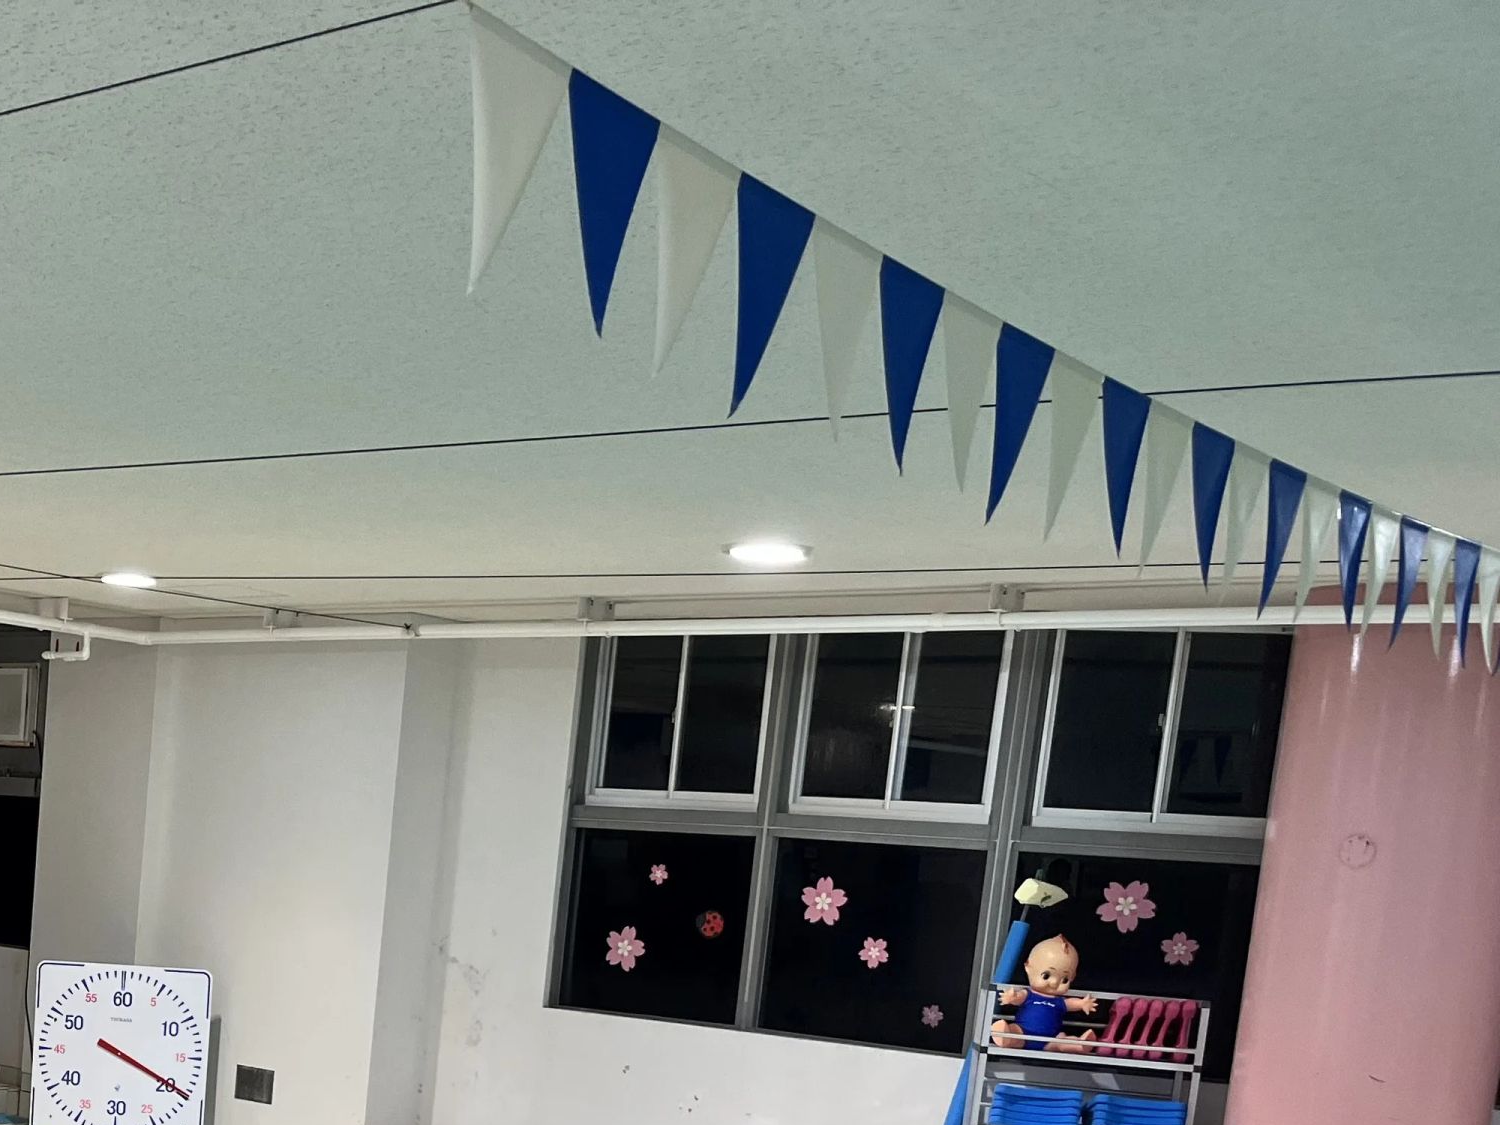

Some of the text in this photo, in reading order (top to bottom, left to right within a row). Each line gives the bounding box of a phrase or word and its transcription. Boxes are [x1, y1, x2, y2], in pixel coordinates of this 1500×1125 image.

[86, 994, 97, 1002] 55
[113, 992, 132, 1007] 60
[150, 998, 156, 1006] 5
[64, 1015, 84, 1030] 50
[162, 1022, 179, 1036] 10
[54, 1045, 66, 1054] 45
[176, 1053, 186, 1062] 15
[61, 1070, 80, 1086] 40
[156, 1078, 176, 1092] 20
[80, 1100, 91, 1109] 35
[107, 1100, 126, 1115] 30
[142, 1104, 153, 1113] 25
